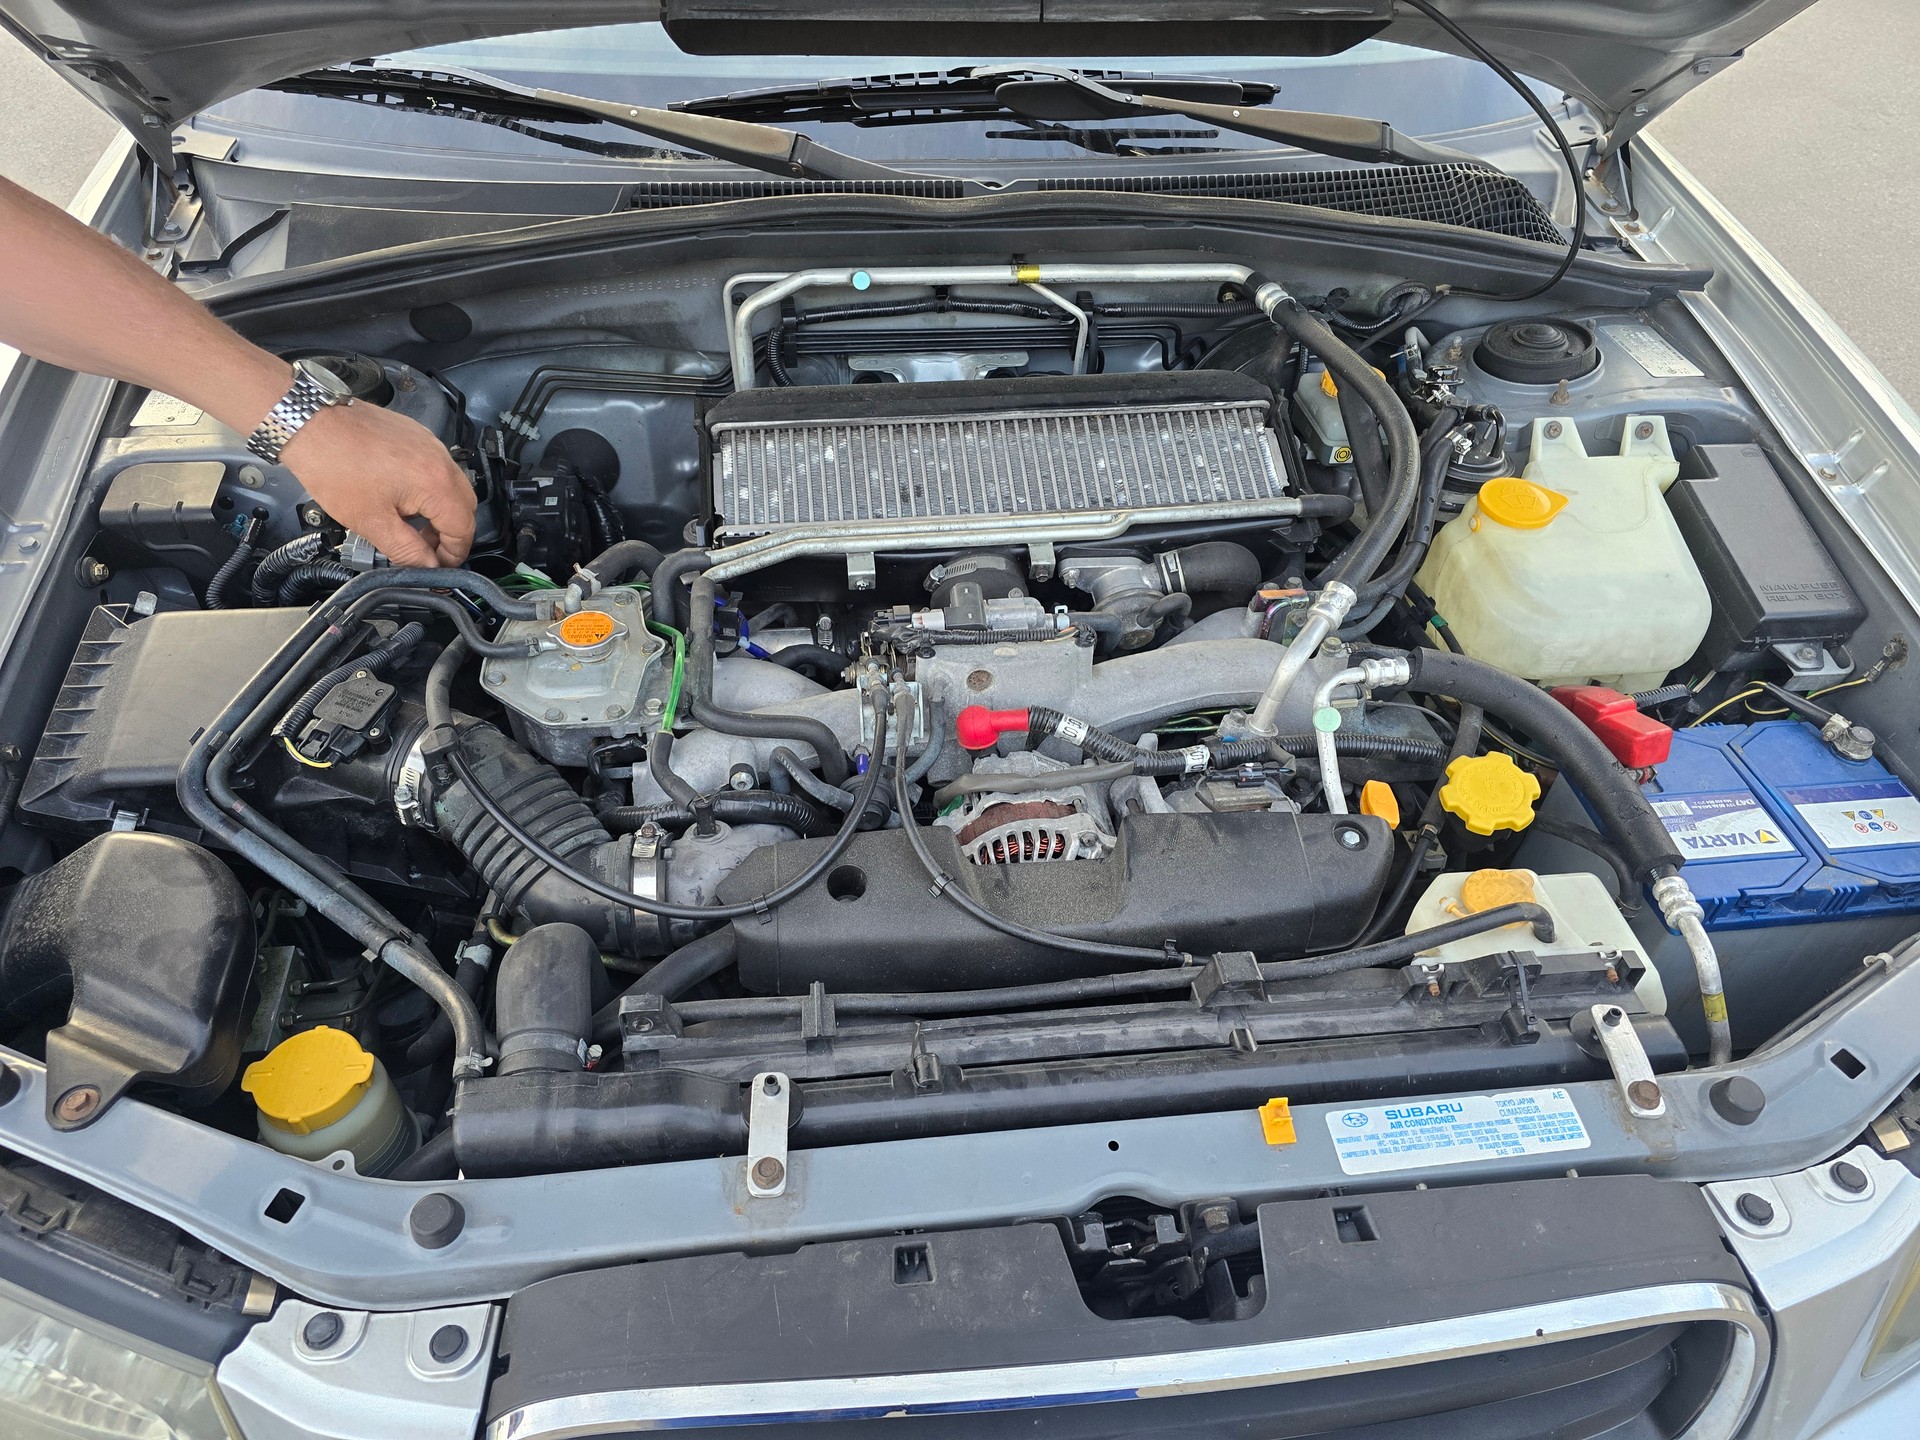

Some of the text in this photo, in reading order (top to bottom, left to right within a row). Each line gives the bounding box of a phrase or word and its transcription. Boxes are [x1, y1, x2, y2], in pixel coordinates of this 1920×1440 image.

[1759, 582, 1839, 591] MAIN FUSE
[1765, 594, 1809, 602] RELAY
[1738, 799, 1755, 807] D47
[1681, 833, 1756, 850] VARTA
[1552, 1091, 1565, 1100] AE
[1495, 1097, 1535, 1107] TOKYO JAPAN
[1385, 1102, 1463, 1120] SUBARU
[1499, 1106, 1541, 1116] CLIMATISEUR
[1390, 1115, 1457, 1129] AIR CONDITIONER
